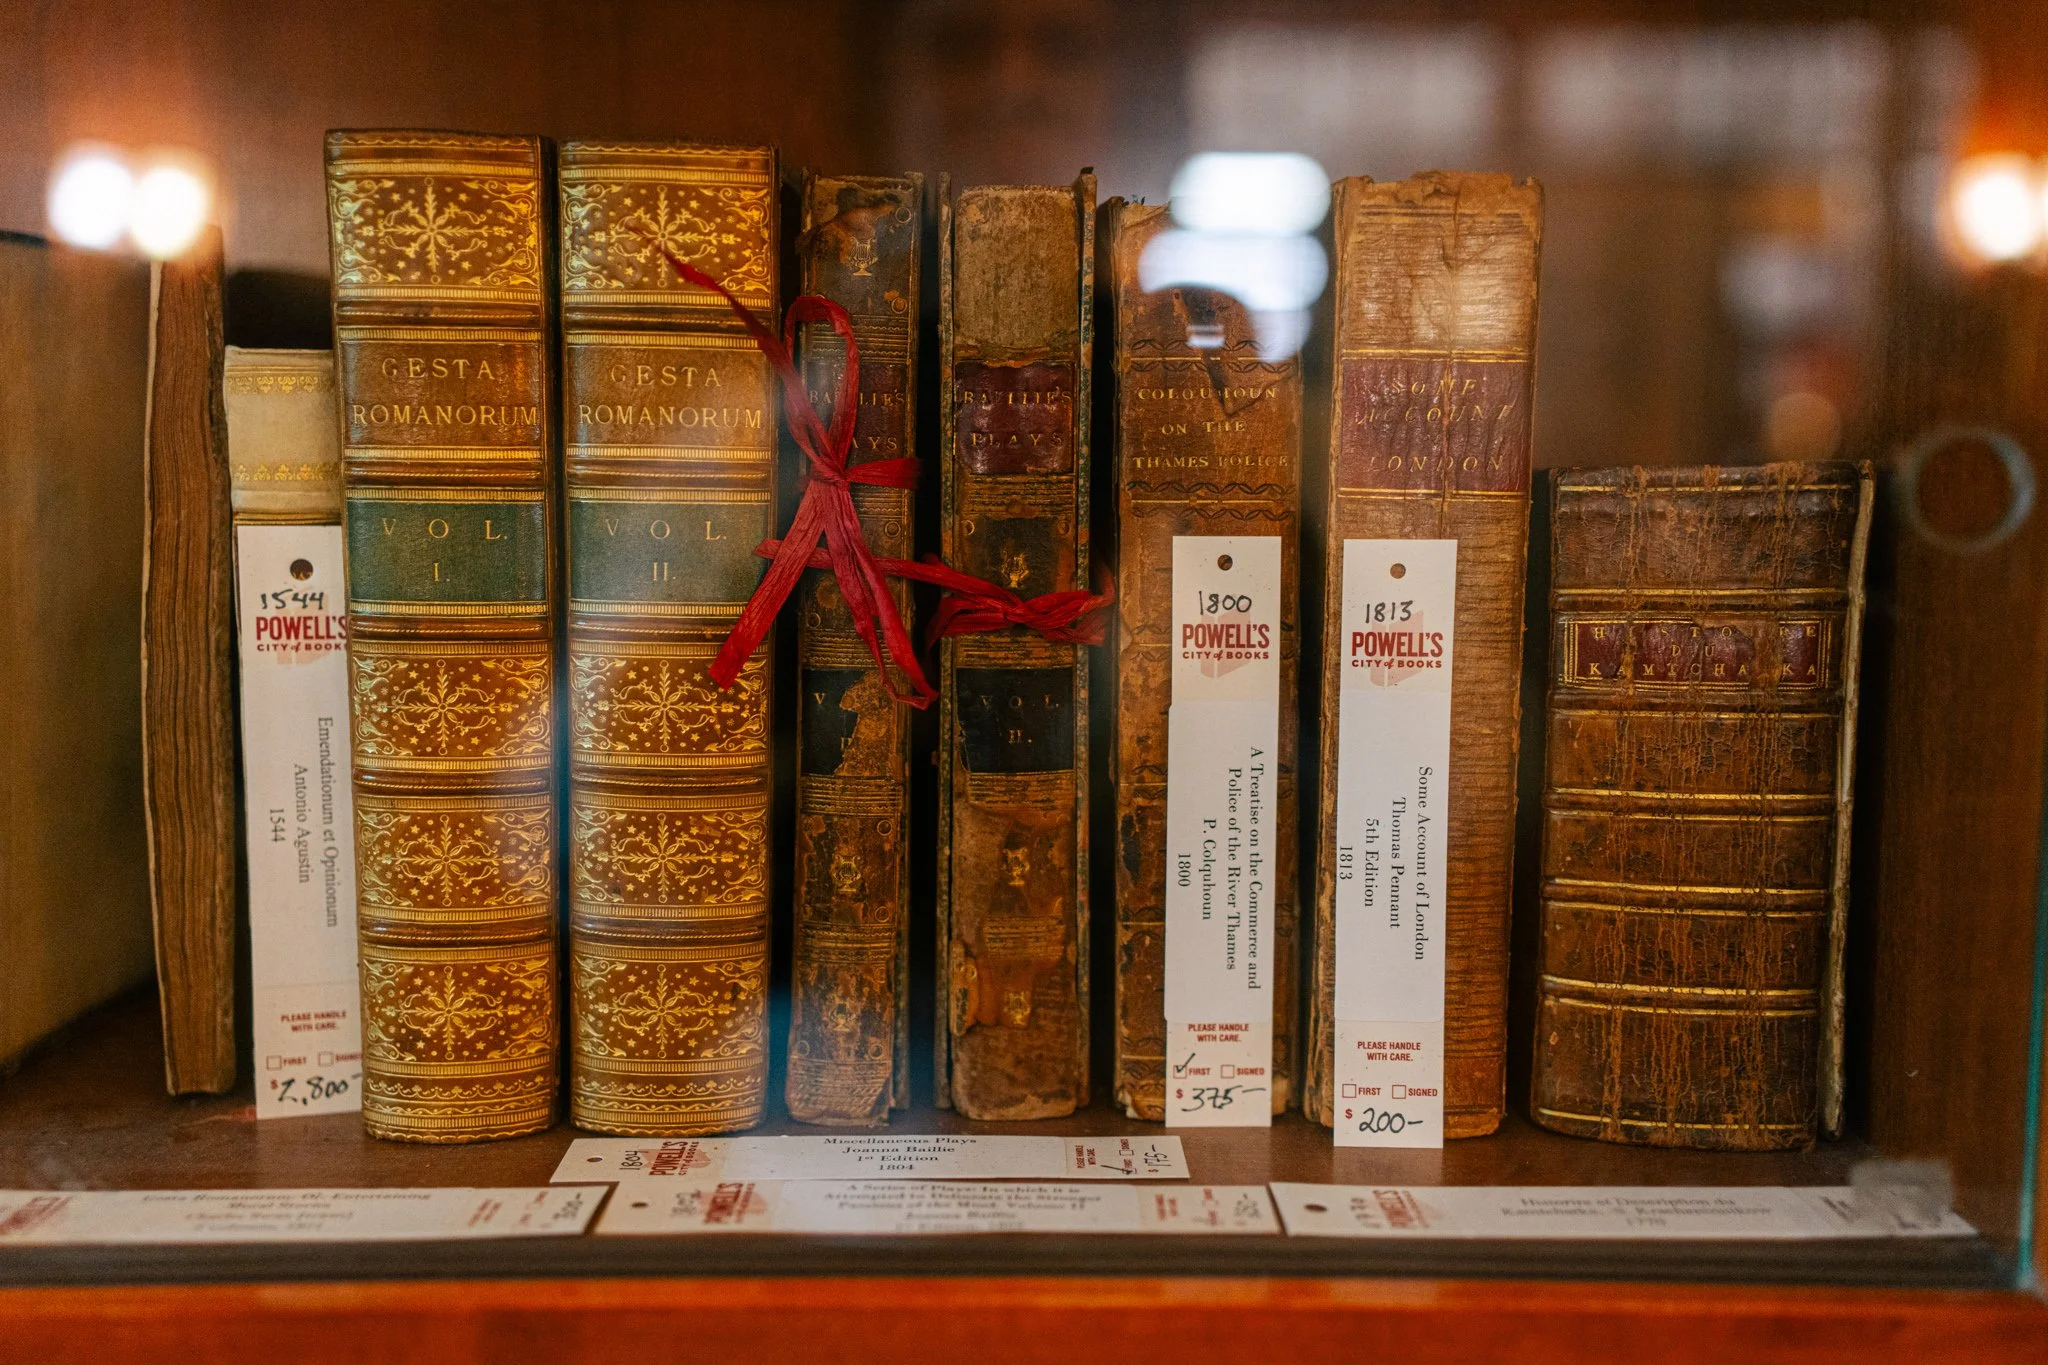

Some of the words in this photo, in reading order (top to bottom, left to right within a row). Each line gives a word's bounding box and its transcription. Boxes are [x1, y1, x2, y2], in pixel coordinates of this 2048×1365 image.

[381, 358, 496, 380] GESTA
[610, 364, 721, 387] GESTA
[352, 404, 538, 427] ROMANORUM
[579, 404, 762, 430] ROMANORUM
[1161, 423, 1187, 435] ON
[1202, 421, 1245, 433] THE
[1133, 456, 1209, 469] THAMES
[1218, 455, 1288, 467] POLICE
[1367, 455, 1503, 473] LONDON
[261, 588, 324, 610] 1544
[1199, 590, 1252, 615] 1800
[1365, 600, 1413, 623] 1813
[256, 616, 347, 640] POWELL'S
[1182, 624, 1270, 648] POWELL'S
[257, 644, 288, 652] CITY
[291, 642, 301, 653] of
[305, 643, 347, 651] BOOK
[1183, 651, 1211, 659] CITY
[1213, 650, 1223, 661] of
[1226, 651, 1269, 659] BOOKS
[1352, 632, 1443, 657] POWELL'S
[1672, 645, 1716, 657] DU
[1352, 659, 1382, 667] CITY
[1384, 658, 1394, 669] of
[1397, 660, 1442, 668] BOOKS
[1251, 747, 1263, 758] A
[318, 717, 334, 825] Emendationum
[294, 764, 312, 823] Antonio
[1229, 768, 1242, 813] Police
[1250, 763, 1264, 825] Treatise
[1417, 766, 1433, 808] Some
[270, 809, 286, 842] 1544
[323, 828, 335, 842] et
[1203, 818, 1217, 834] P.
[1229, 818, 1242, 834] of
[1365, 818, 1380, 844] 5th
[1391, 797, 1406, 859] Thomas
[1228, 838, 1241, 861] the
[1250, 830, 1259, 847] on
[1416, 813, 1431, 877] Account
[294, 828, 314, 883] Agustin
[1249, 852, 1263, 876] the
[1339, 846, 1353, 880] 1813
[1178, 853, 1191, 887] 1800
[1199, 839, 1217, 921] Colquhoun
[1364, 850, 1379, 907] Edition
[320, 846, 340, 928] Opinionum
[1228, 867, 1241, 908] River
[1390, 865, 1405, 929] Pennant
[1416, 882, 1430, 899] of
[1249, 881, 1263, 958] Commerce
[1415, 902, 1430, 960] London
[1226, 912, 1240, 970] Thames
[1248, 963, 1261, 989] and
[281, 1012, 311, 1022] PLEASE
[314, 1010, 346, 1020] HANDLE
[291, 1023, 313, 1032] WITH
[1188, 1023, 1217, 1032] PLEASE
[1218, 1023, 1249, 1032] HANDLE
[1197, 1034, 1217, 1042] WITH
[1357, 1041, 1387, 1050] PLEASE
[1389, 1042, 1421, 1050] HANDLE
[283, 1056, 306, 1066] FIRST
[1390, 1053, 1413, 1061] CARE.
[1358, 1087, 1381, 1095] FIRST
[1408, 1088, 1438, 1096] SIGNED
[842, 1146, 899, 1154] Joanna
[935, 1137, 977, 1146] Plays
[619, 1150, 649, 1170] 1804
[648, 1141, 688, 1175] POWELL'S
